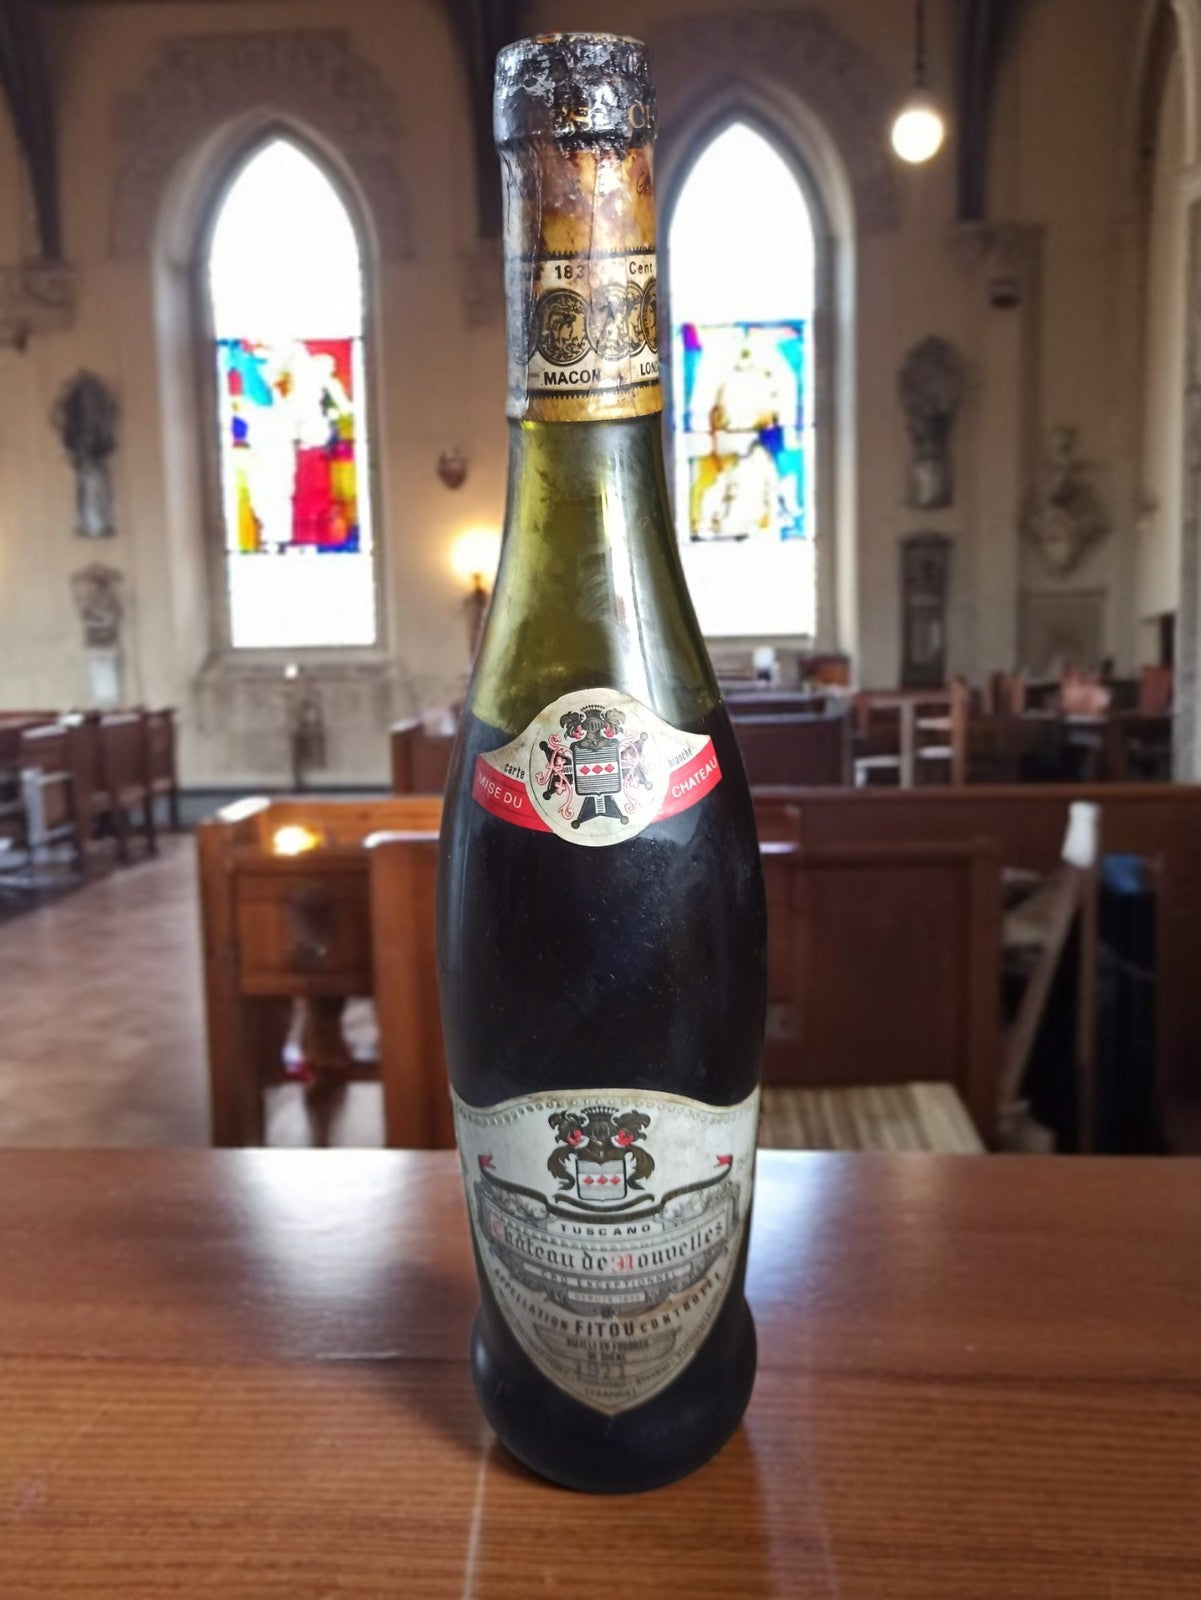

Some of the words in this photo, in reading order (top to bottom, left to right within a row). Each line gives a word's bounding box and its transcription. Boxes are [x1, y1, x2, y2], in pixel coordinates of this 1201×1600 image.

[504, 763, 526, 780] carte
[477, 773, 502, 799] MISE
[503, 791, 523, 809] DU
[671, 759, 718, 798] CHATEAU
[560, 1224, 651, 1236] TUSCANO
[582, 1250, 607, 1271] de
[575, 1320, 635, 1338] FITOU
